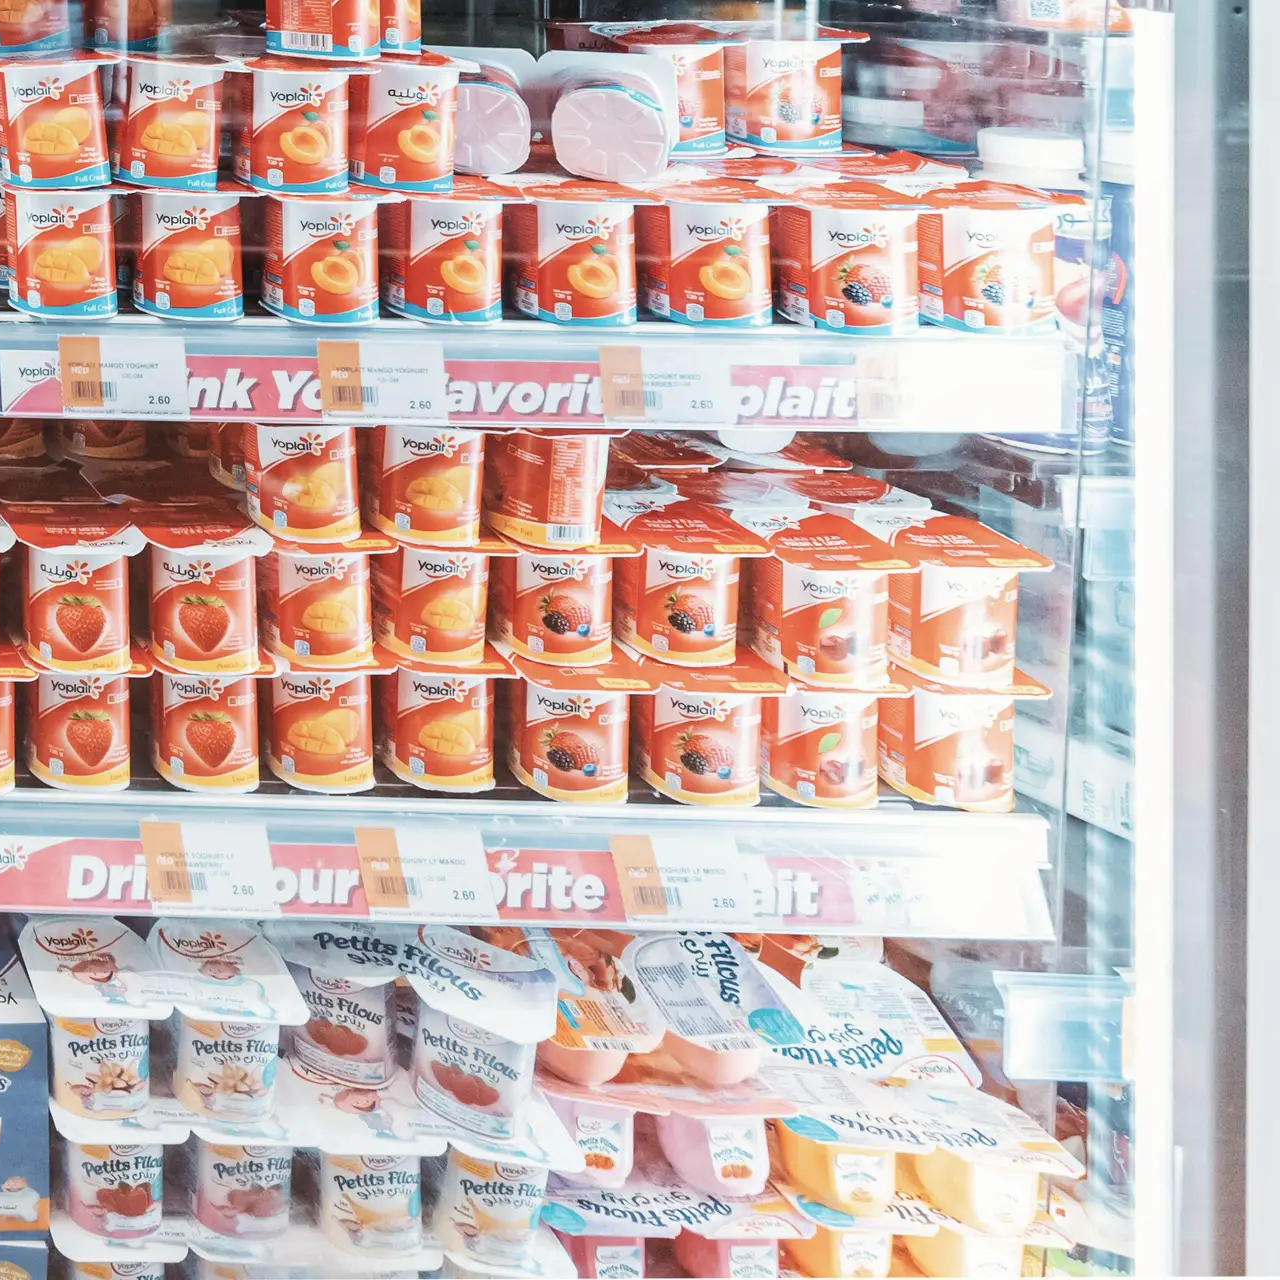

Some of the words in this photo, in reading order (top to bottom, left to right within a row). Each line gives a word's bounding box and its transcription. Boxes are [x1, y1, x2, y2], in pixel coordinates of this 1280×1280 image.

[148, 396, 171, 406] 2.60
[690, 399, 713, 409] 2.60
[452, 890, 475, 901] 2.60
[423, 1028, 469, 1061] Petits
[471, 1047, 519, 1083] Filous
